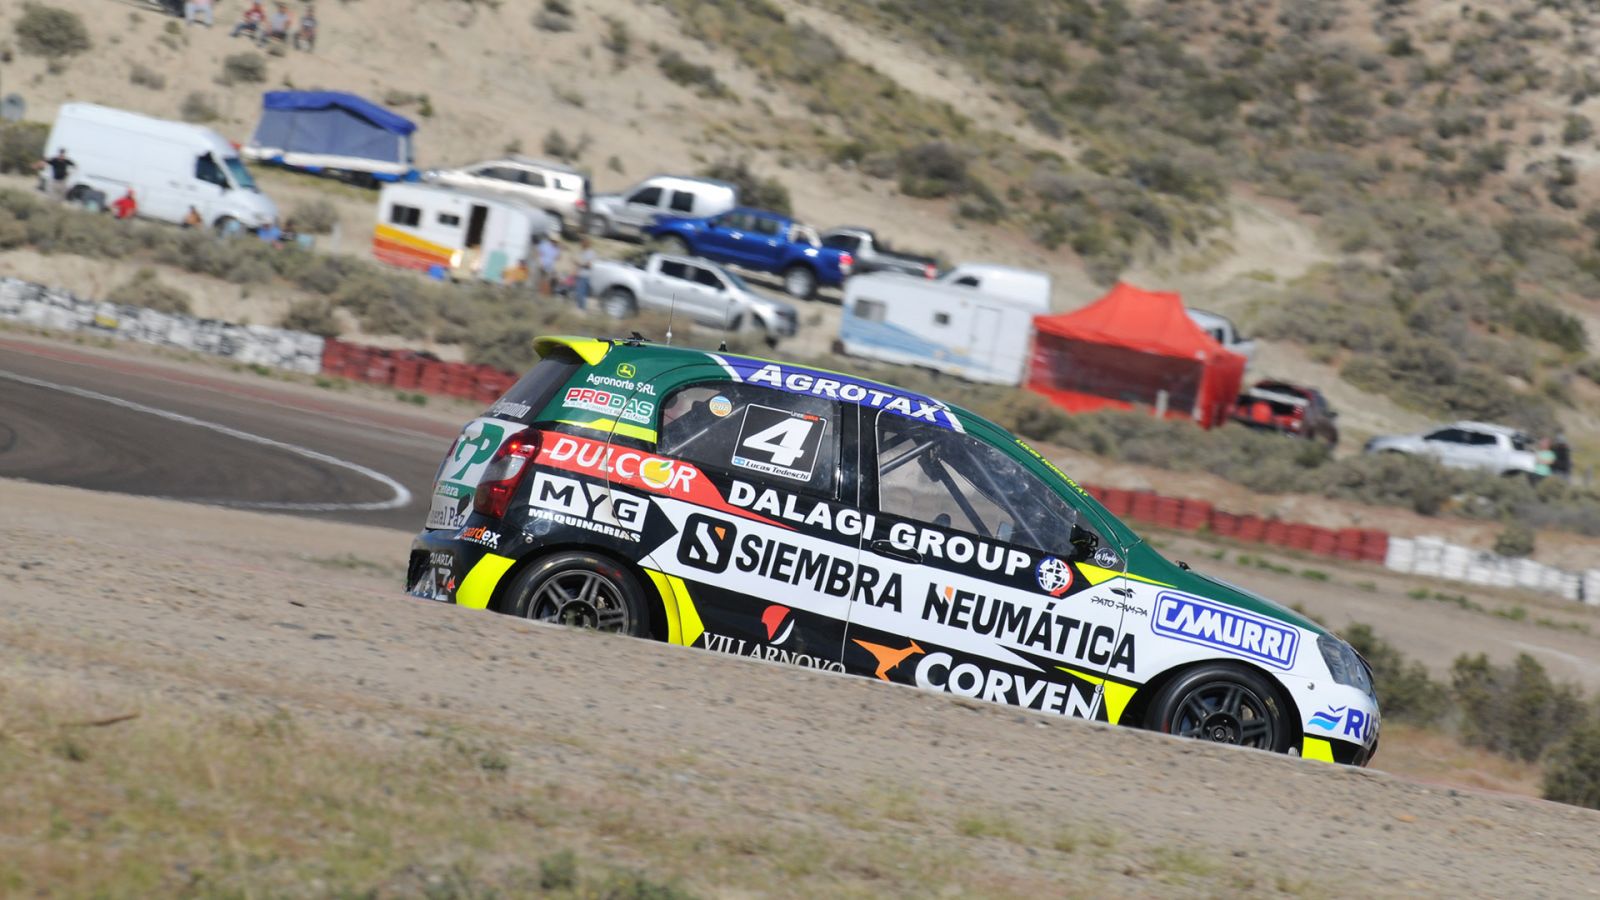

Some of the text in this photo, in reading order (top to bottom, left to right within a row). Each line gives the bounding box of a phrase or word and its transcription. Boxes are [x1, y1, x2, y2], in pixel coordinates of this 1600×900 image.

[564, 387, 654, 417] PRODAS
[586, 373, 656, 396] Agronorte SRL
[750, 364, 945, 422] AGROTAX
[549, 438, 697, 493] DULCOR
[742, 417, 814, 467] 4
[745, 461, 811, 481] Lucas Tedeschi
[537, 476, 641, 524] MYG
[528, 508, 642, 543] MAQUINARIAS
[727, 479, 1031, 577] DALAGI GROUP
[735, 533, 903, 613] SIEMBRA
[921, 582, 1136, 674] NEUMÁTICA
[1090, 595, 1148, 616] PATO PAMPA
[702, 631, 847, 674] VILLARNOVO
[1157, 600, 1296, 662] CAMURRI
[914, 651, 1105, 721] CORVEN
[1343, 708, 1377, 745] RU
